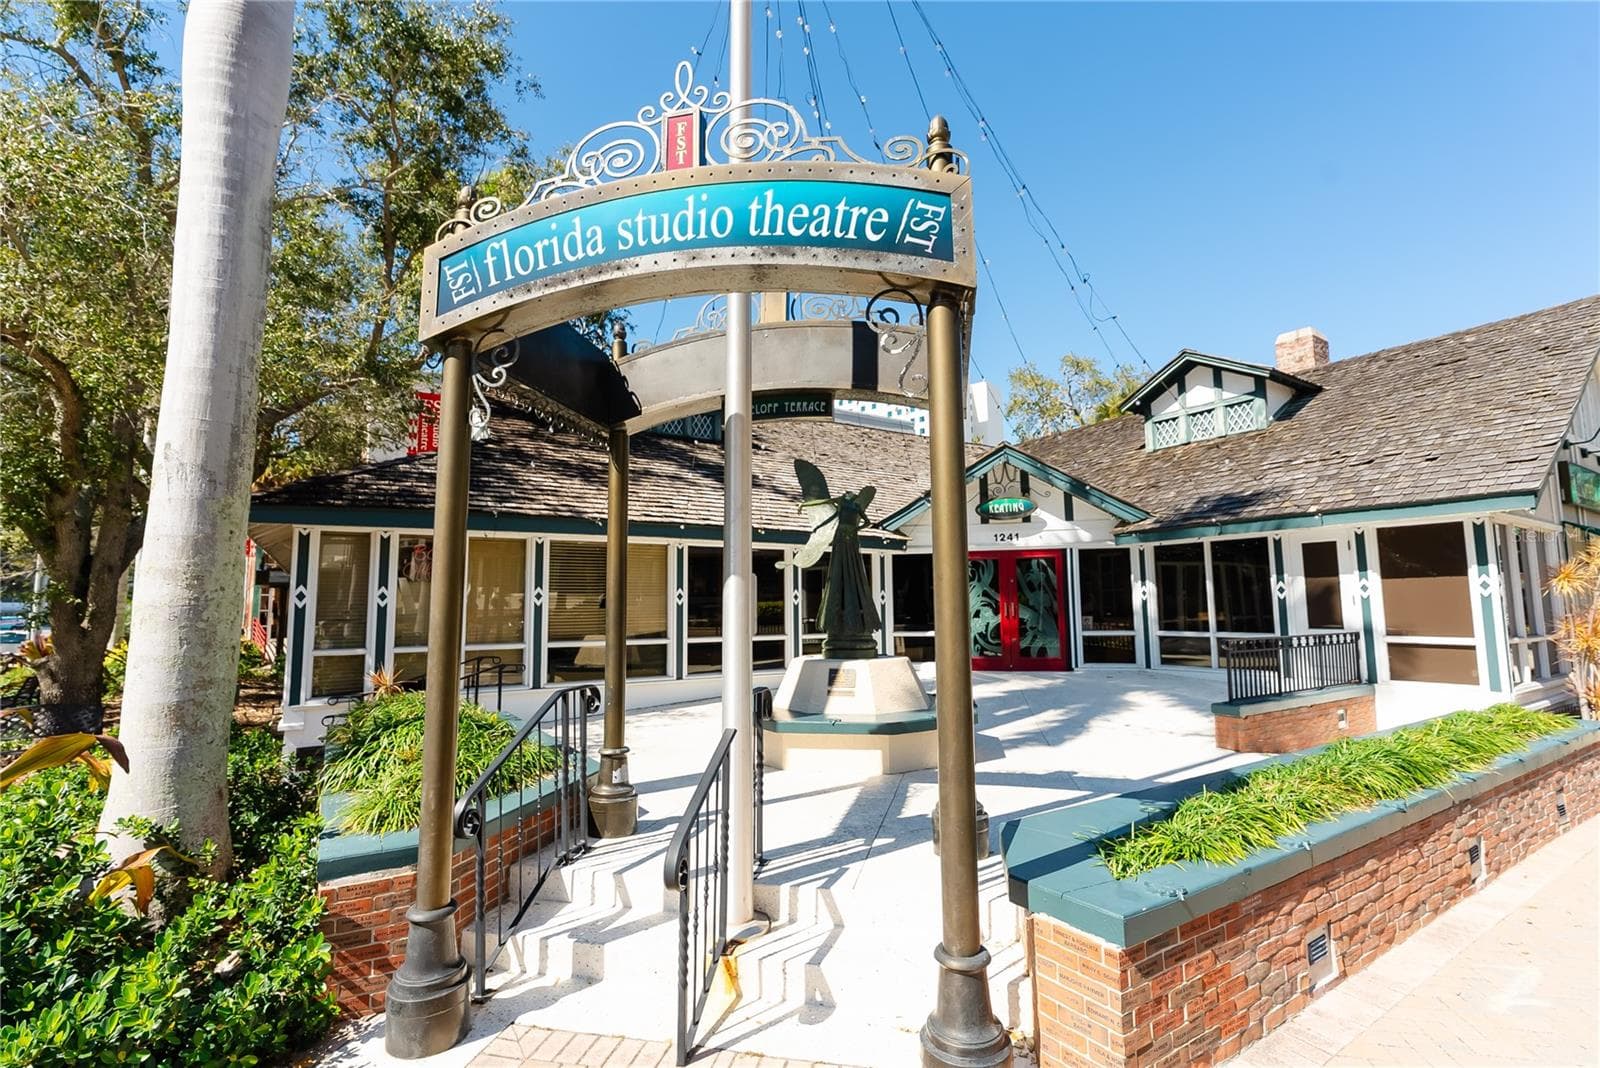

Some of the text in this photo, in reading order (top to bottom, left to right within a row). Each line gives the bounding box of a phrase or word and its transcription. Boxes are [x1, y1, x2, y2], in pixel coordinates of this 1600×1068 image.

[675, 121, 688, 165] FST
[484, 189, 889, 288] florida studio theatre
[903, 200, 947, 253] FST
[443, 259, 477, 304] FST
[783, 401, 826, 412] TERRACE
[988, 502, 1025, 513] KEATING
[993, 532, 1019, 542] 1241
